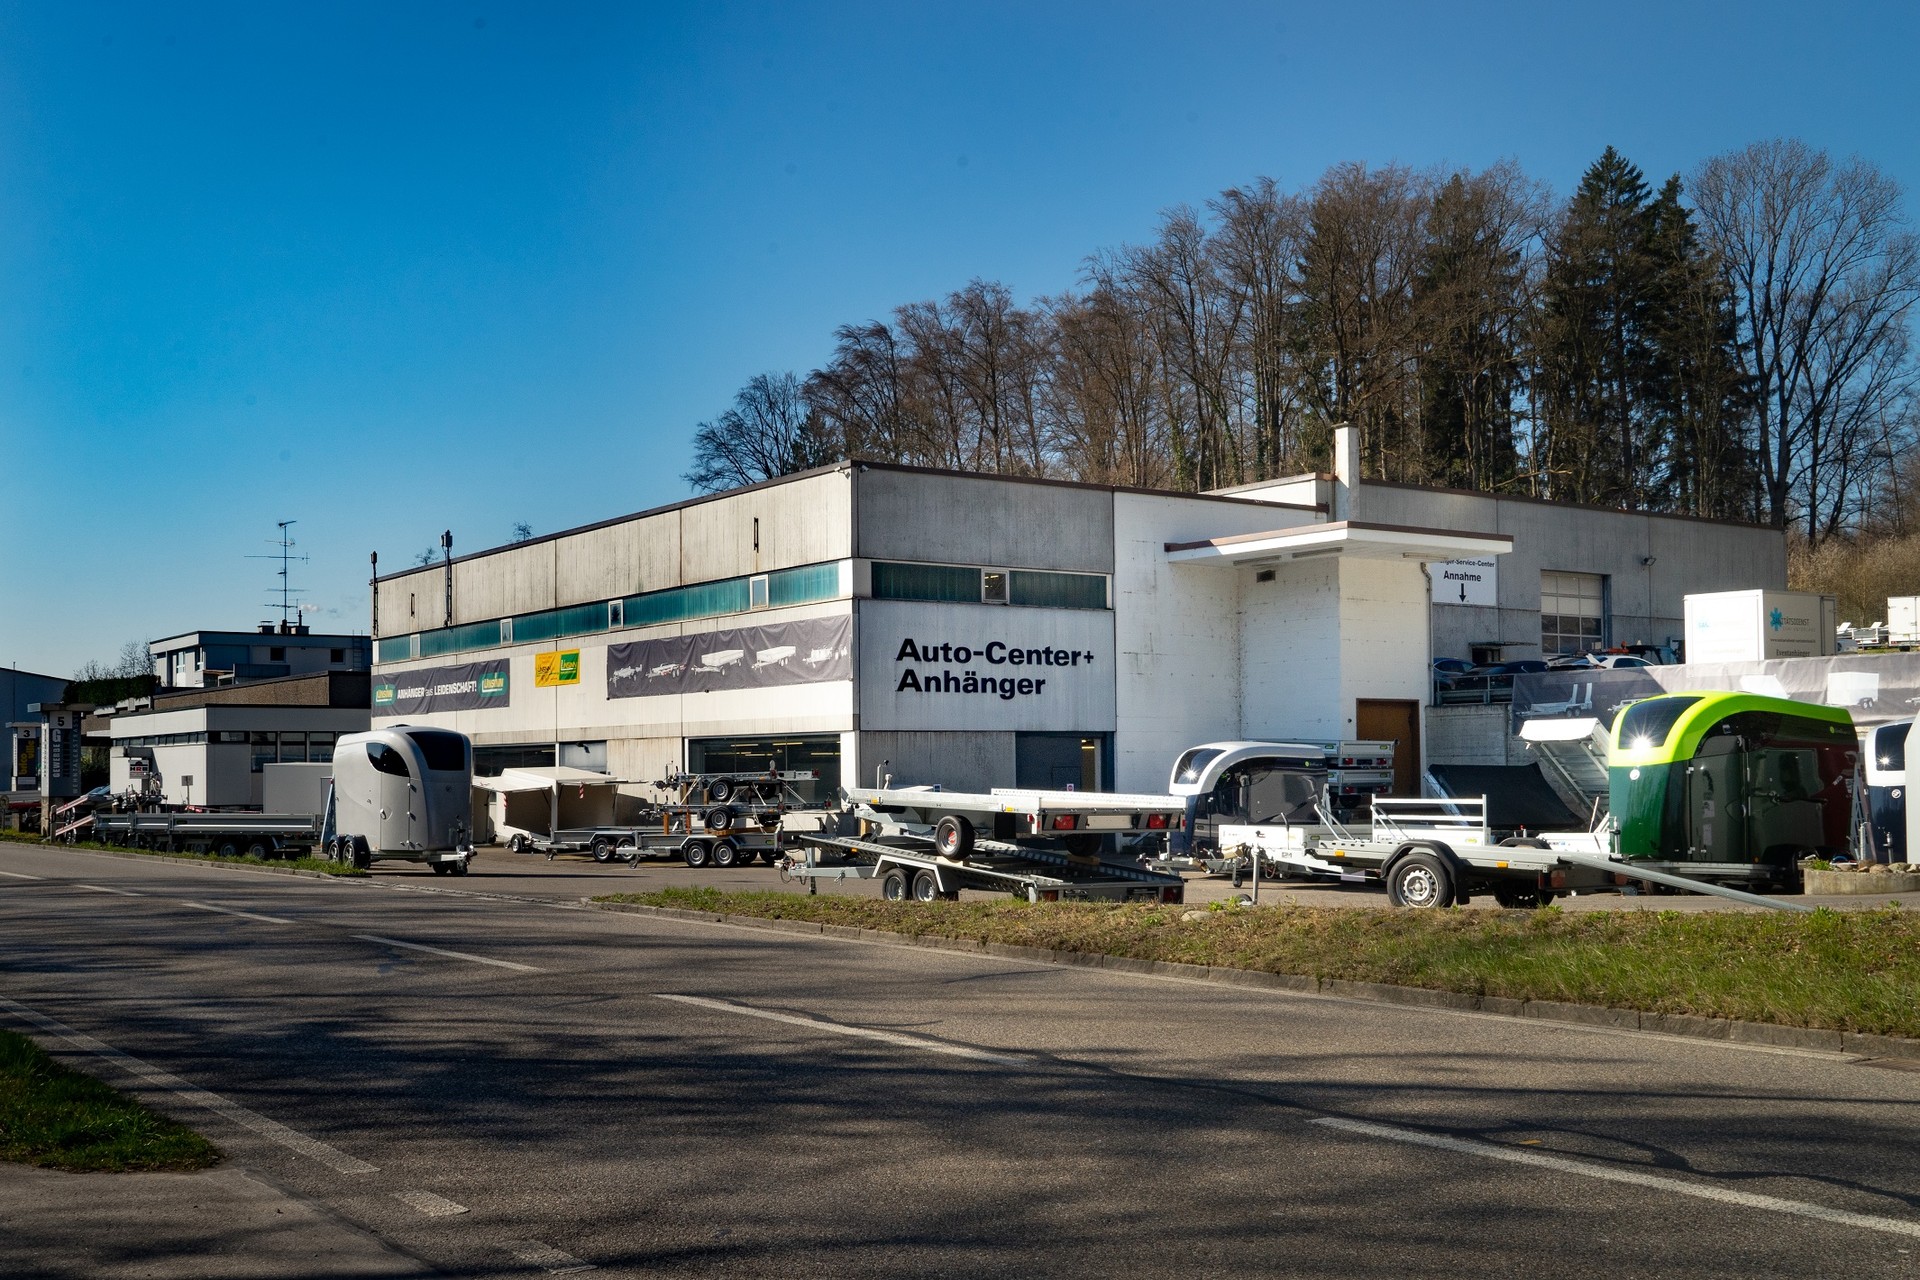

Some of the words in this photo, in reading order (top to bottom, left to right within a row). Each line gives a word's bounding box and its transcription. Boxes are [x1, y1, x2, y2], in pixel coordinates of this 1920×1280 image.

[1443, 570, 1482, 582] Annahme
[896, 638, 1095, 667] Auto-Center+
[397, 686, 425, 700] ANHÄNGER
[434, 680, 477, 696] LEIDENSCHAFT!
[897, 669, 1046, 700] Anhänger
[57, 716, 65, 727] 5
[23, 729, 31, 738] 3
